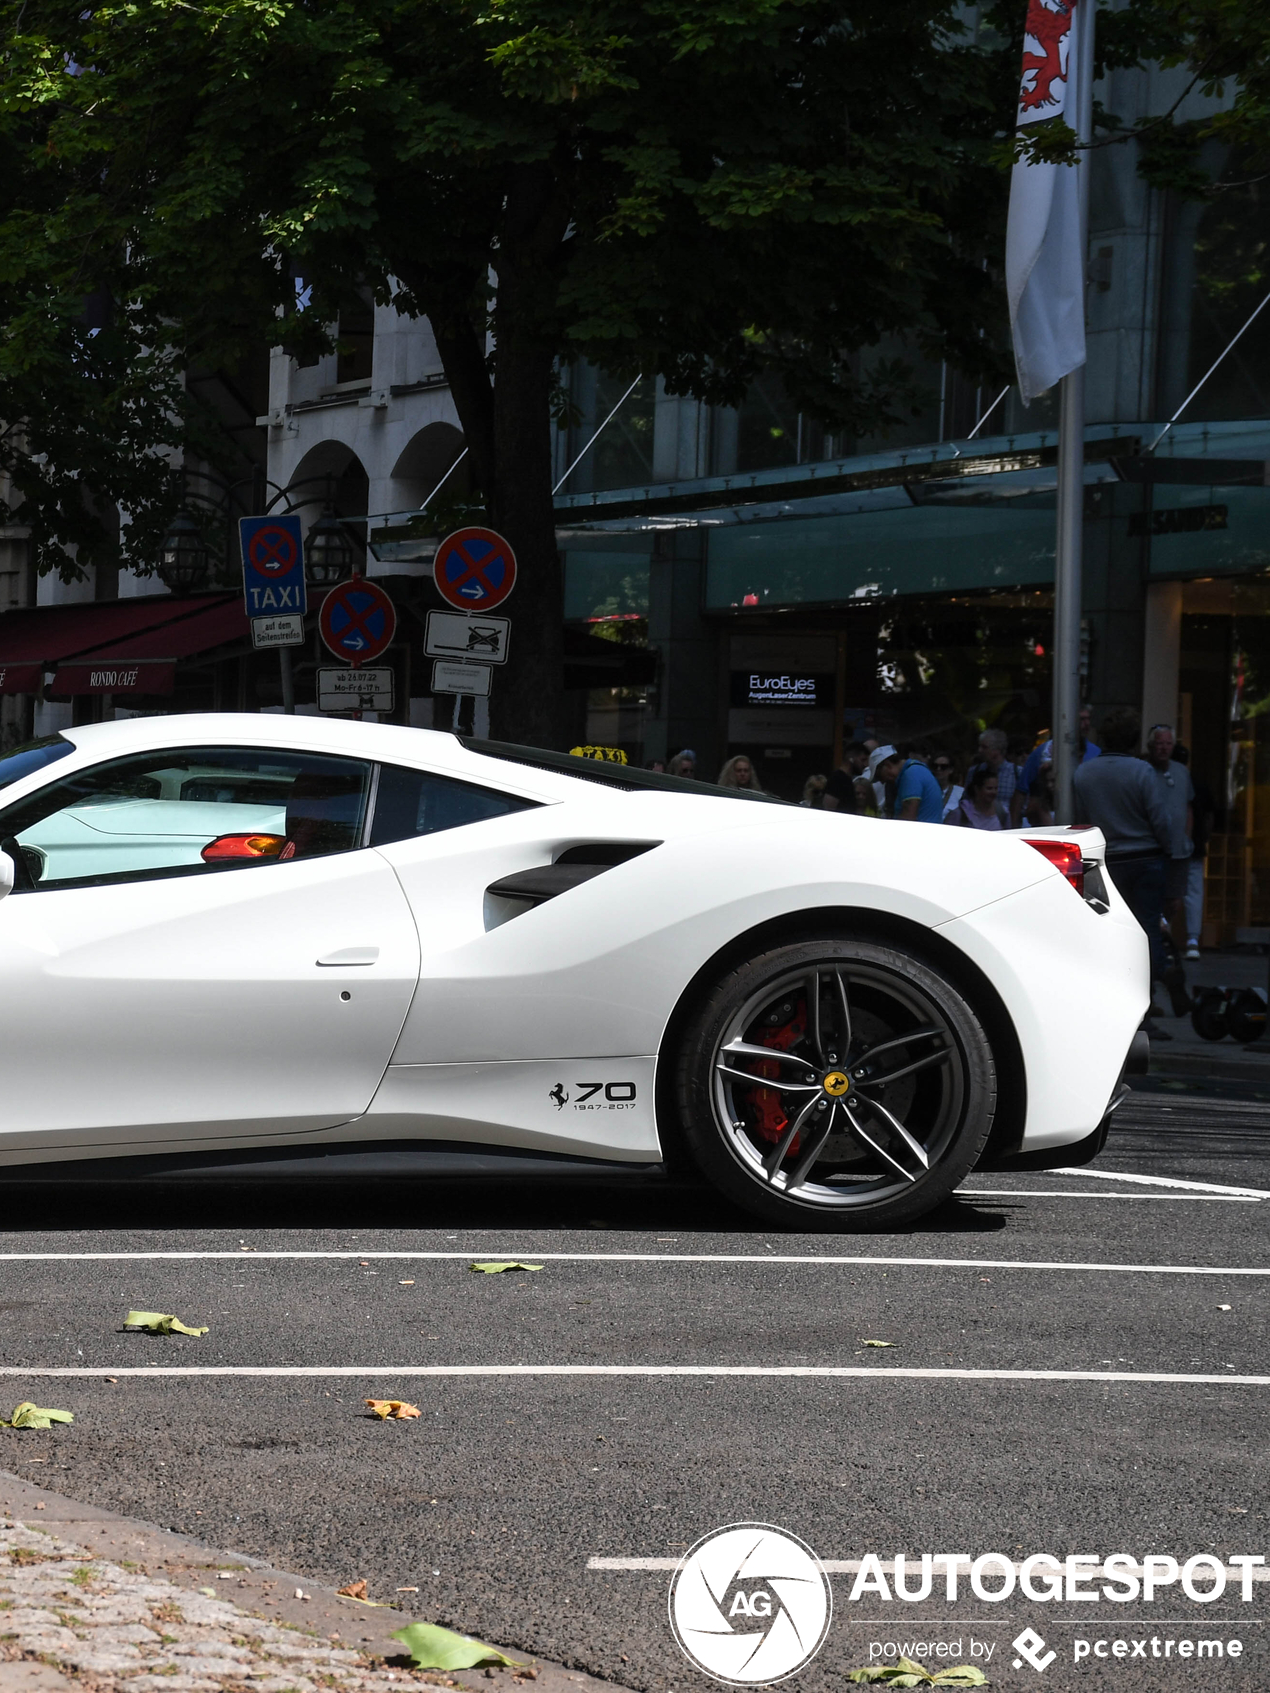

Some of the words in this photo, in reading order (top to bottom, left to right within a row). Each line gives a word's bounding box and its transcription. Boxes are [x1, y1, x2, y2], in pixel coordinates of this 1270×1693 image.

[250, 585, 301, 609] TAXI
[265, 622, 276, 631] auf
[278, 621, 292, 629] dem
[256, 629, 301, 643] Seitenstreifen
[90, 671, 117, 687] RONDO
[117, 666, 139, 686] CAFÉ
[337, 673, 346, 682] ab
[749, 674, 816, 693] EuroEyes
[334, 684, 356, 692] Mo-Fr
[574, 1082, 637, 1102] 70
[573, 1103, 636, 1111] 1947-2017
